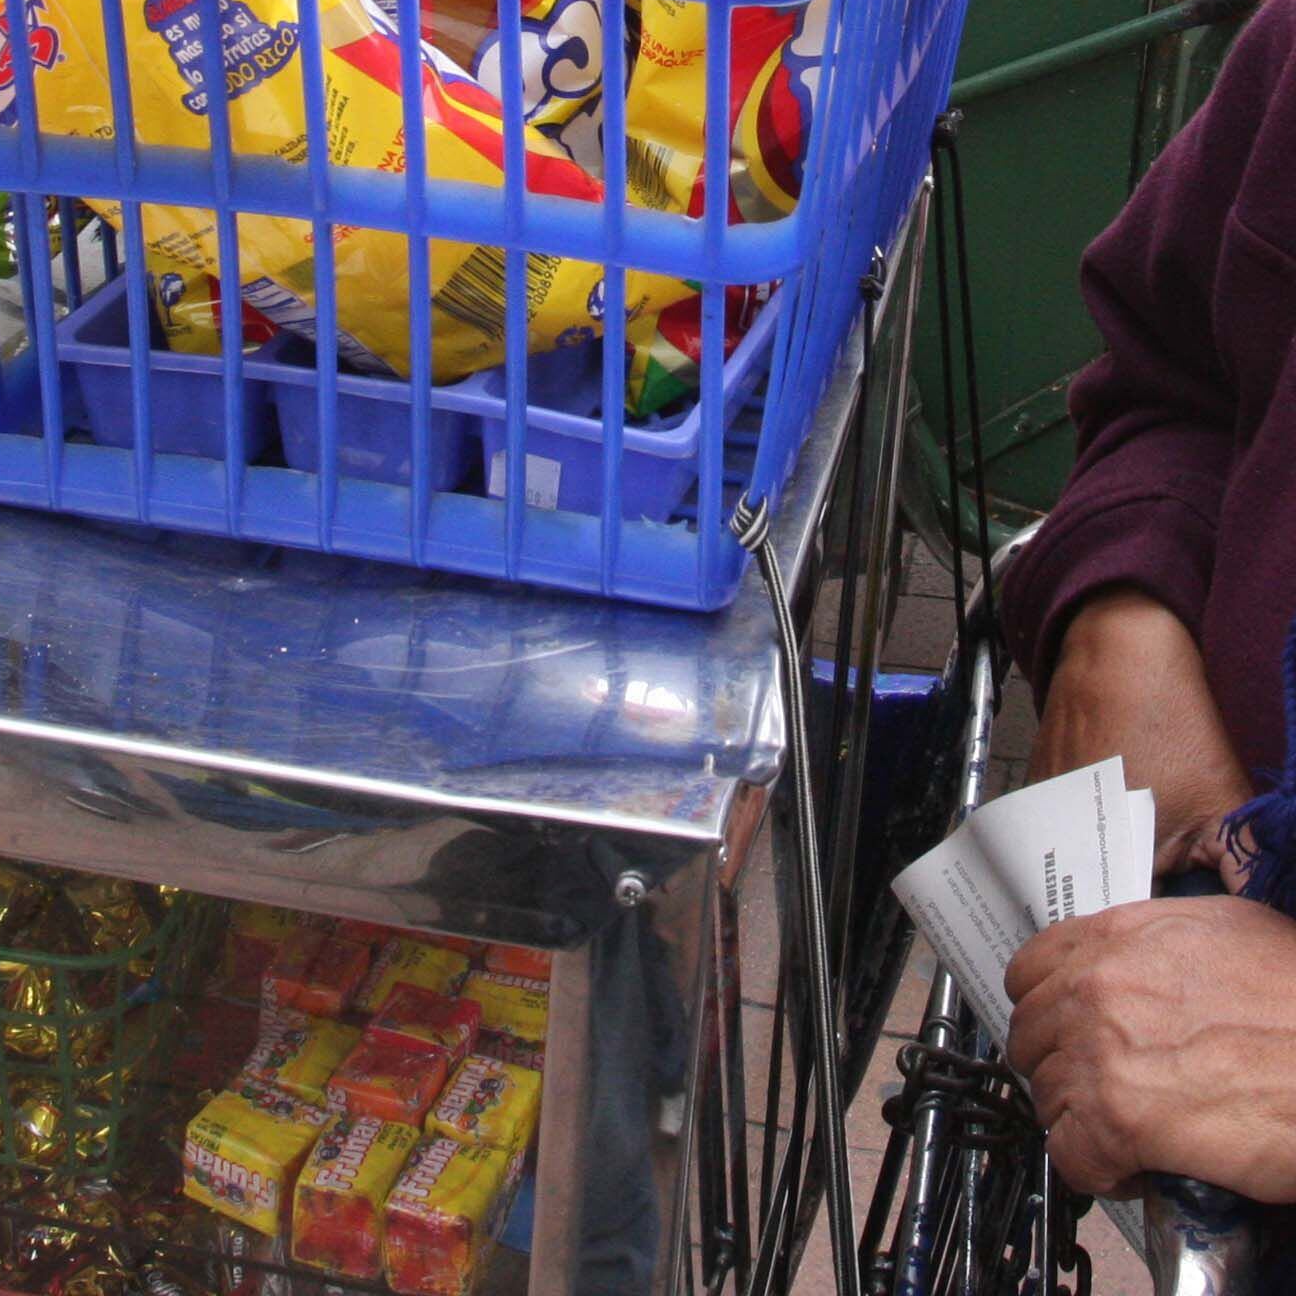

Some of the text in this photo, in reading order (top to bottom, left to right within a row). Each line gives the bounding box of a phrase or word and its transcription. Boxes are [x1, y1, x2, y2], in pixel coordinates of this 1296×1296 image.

[165, 24, 184, 42] es
[174, 39, 206, 65] más
[235, 8, 252, 29] si
[185, 67, 204, 85] lo
[1048, 908, 1059, 924] LA
[315, 1115, 384, 1190] Frunas
[185, 1141, 277, 1209] Frunas
